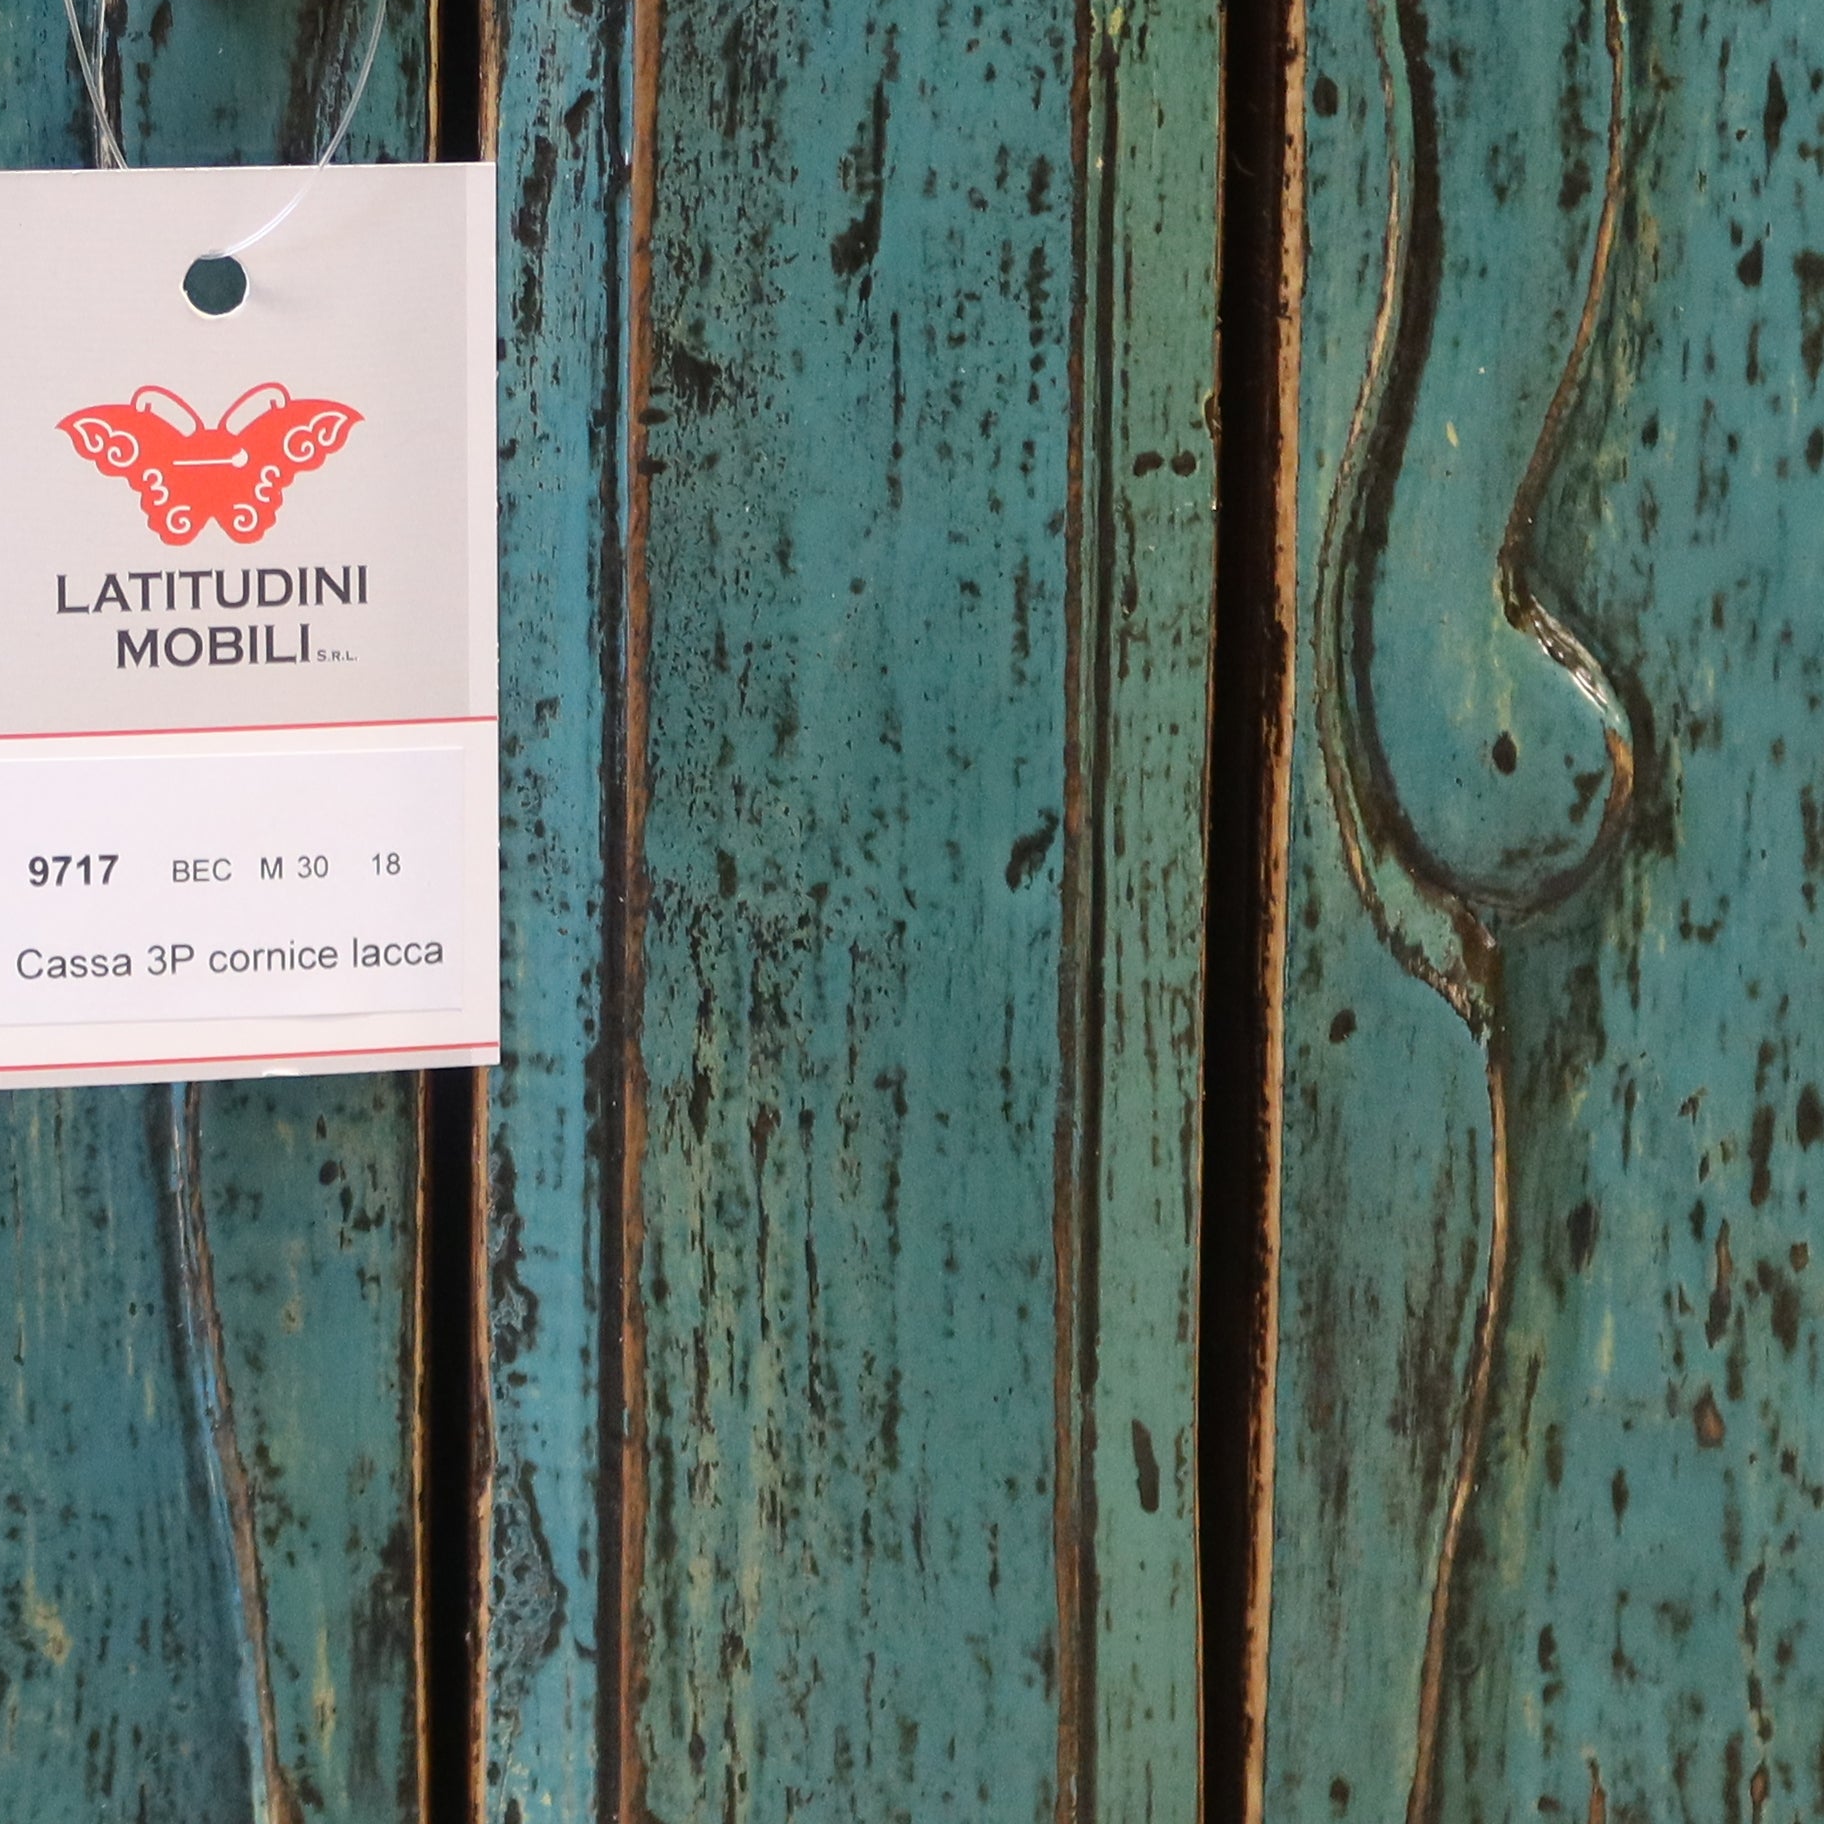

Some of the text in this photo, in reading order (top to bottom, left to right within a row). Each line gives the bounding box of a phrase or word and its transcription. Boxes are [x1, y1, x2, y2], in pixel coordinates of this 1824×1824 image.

[56, 564, 368, 614] LATITUDINI
[115, 622, 310, 669] MOBILI
[27, 851, 402, 887] 9717 BEC M 30 18
[15, 937, 444, 981] Cassa 3P cornice lacca
